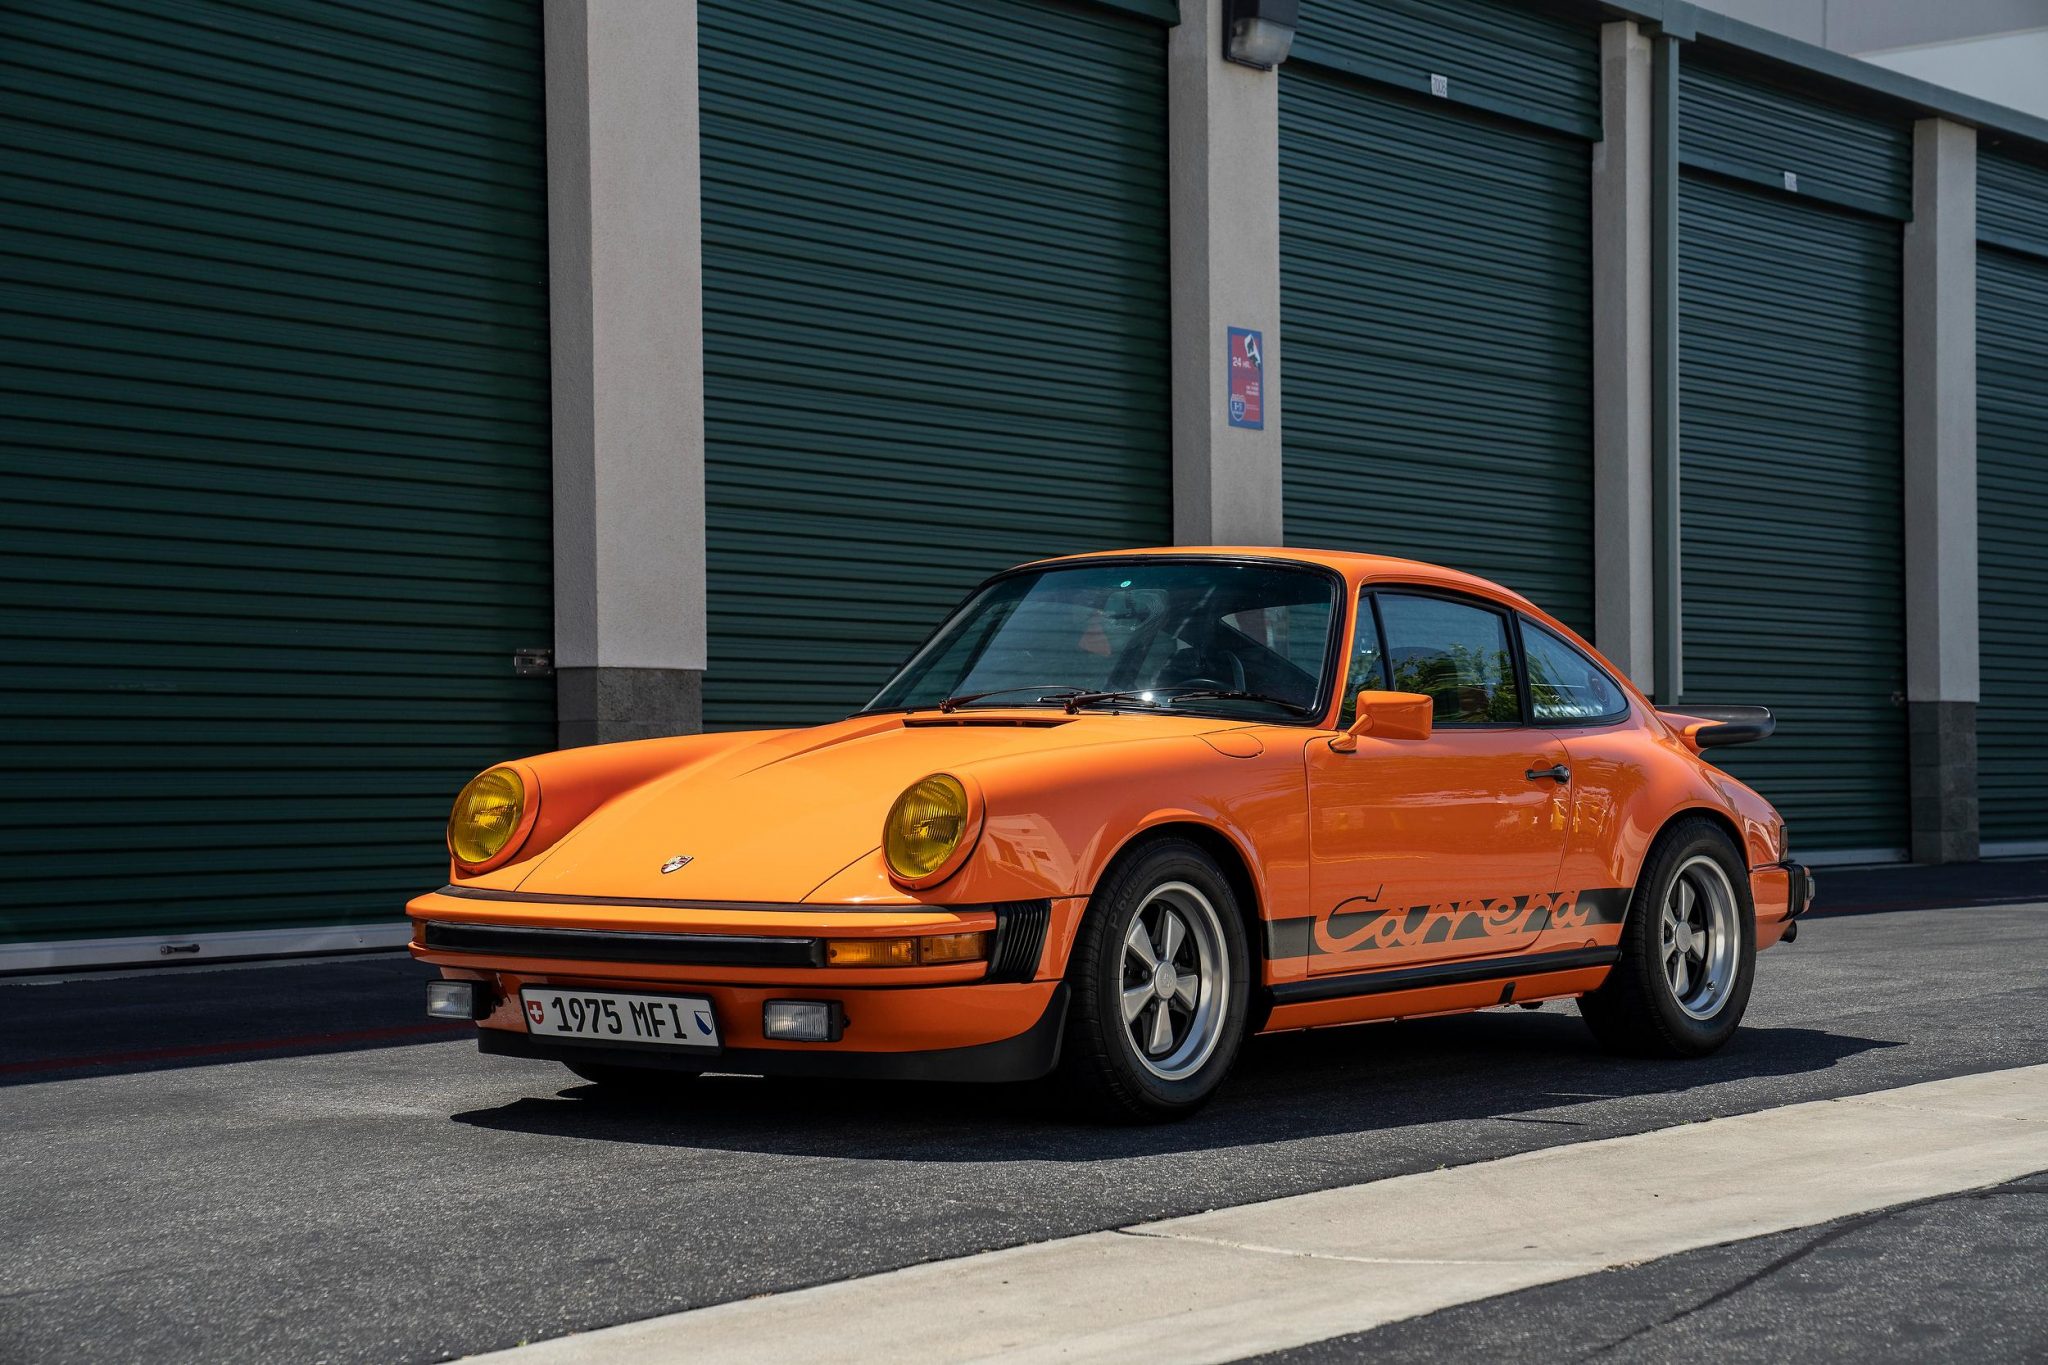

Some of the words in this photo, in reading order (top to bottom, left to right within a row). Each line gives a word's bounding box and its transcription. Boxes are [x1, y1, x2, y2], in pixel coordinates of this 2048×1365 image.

[1232, 356, 1242, 368] 24
[1314, 884, 1592, 953] Carrera
[552, 996, 623, 1035] 1975
[629, 1000, 687, 1040] MFI
